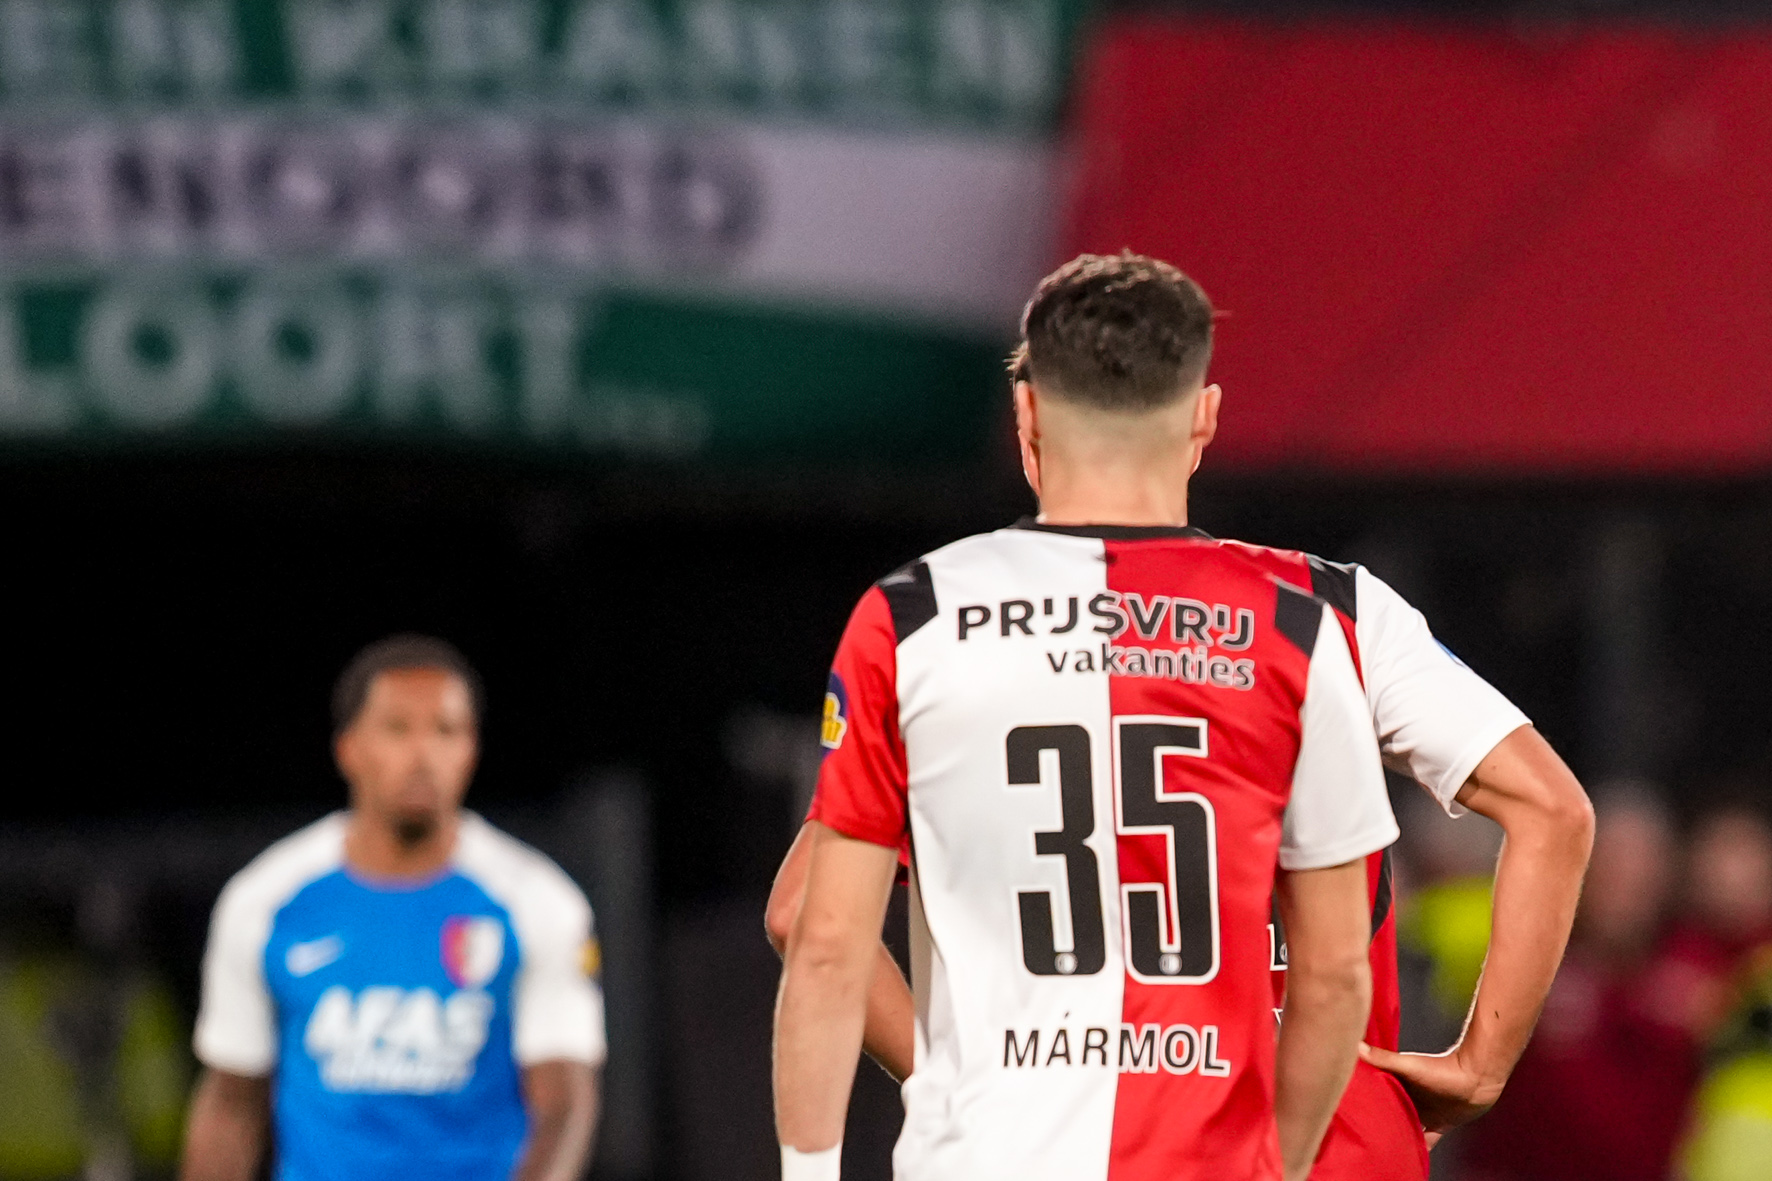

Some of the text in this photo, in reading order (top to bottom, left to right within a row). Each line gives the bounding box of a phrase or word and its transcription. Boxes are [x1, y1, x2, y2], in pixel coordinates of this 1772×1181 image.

[1046, 643, 1256, 691] vakanties
[1006, 716, 1219, 985] 35
[1003, 1011, 1231, 1077] MÁRMOL
